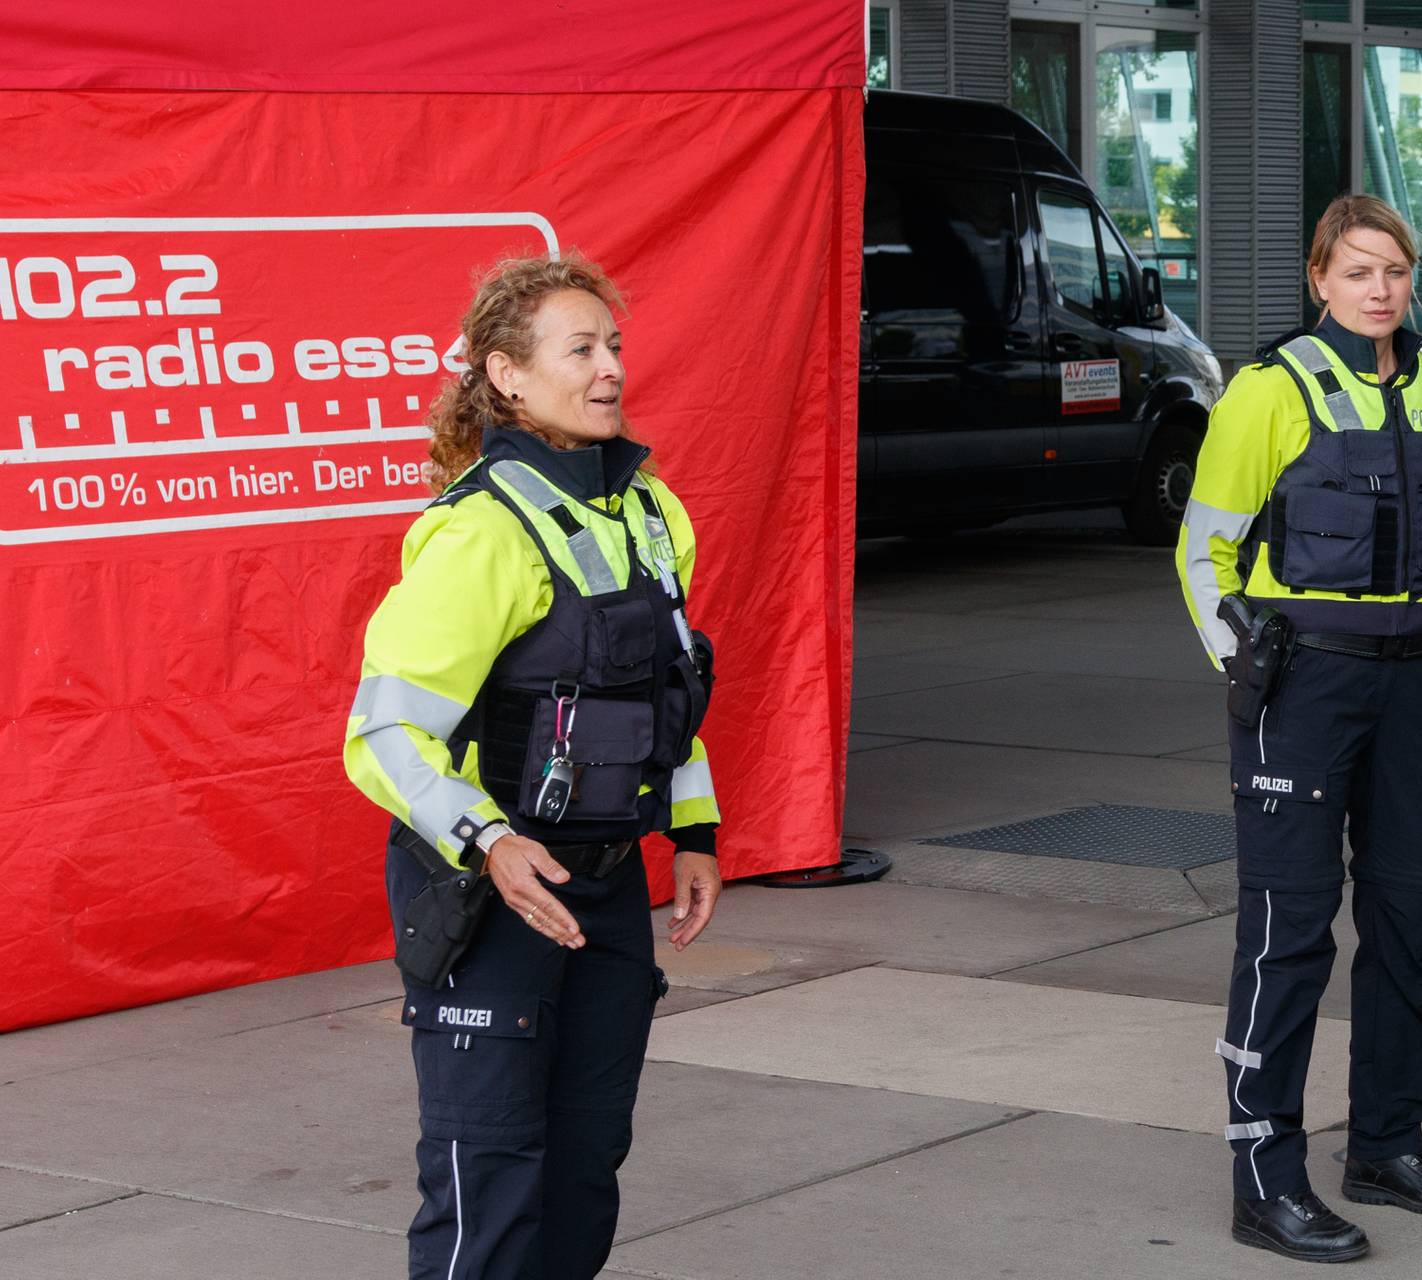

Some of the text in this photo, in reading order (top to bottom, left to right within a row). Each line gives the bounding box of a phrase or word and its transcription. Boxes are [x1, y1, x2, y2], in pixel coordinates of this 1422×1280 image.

[43, 327, 275, 392] radio
[1064, 362, 1117, 379] AVT events
[28, 472, 146, 512] 100%
[157, 476, 218, 503] von
[228, 464, 300, 498] hier.
[312, 459, 371, 492] Der
[1252, 775, 1293, 793] POLIZEI
[438, 1006, 492, 1027] POLIZEI
